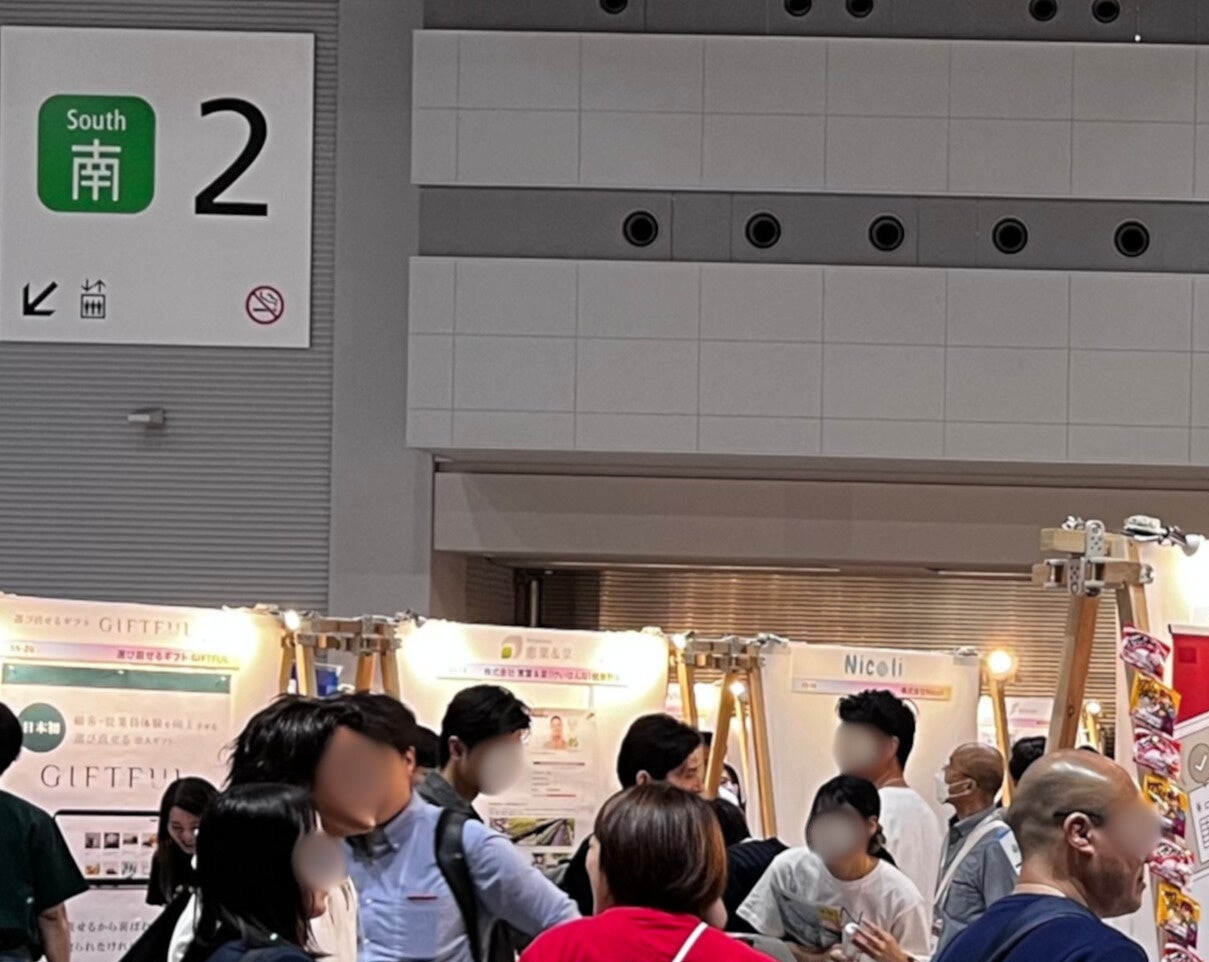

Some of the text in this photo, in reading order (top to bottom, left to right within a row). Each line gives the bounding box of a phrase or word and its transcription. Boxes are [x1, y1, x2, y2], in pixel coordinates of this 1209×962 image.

[66, 108, 127, 131] South
[71, 138, 122, 202] 南
[194, 96, 268, 216] 2
[845, 654, 903, 678] Nicoli
